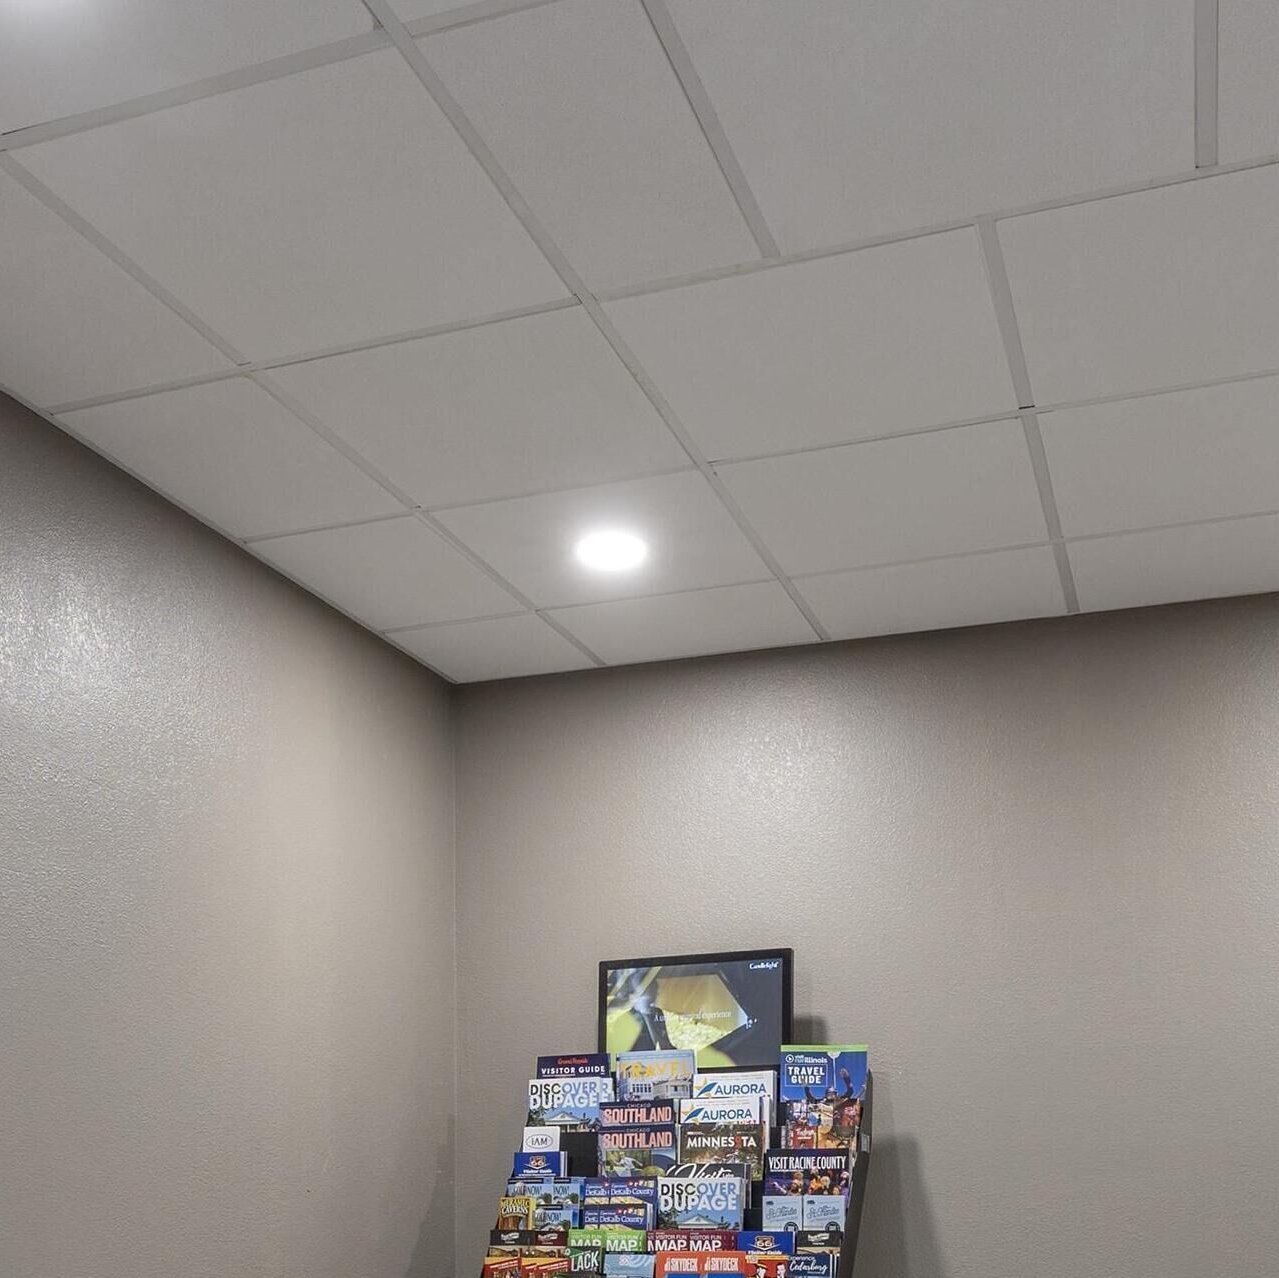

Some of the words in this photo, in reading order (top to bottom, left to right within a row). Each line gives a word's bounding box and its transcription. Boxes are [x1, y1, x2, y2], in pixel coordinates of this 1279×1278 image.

[750, 962, 779, 970] Candlelight
[620, 1060, 688, 1079] TRAVEL
[788, 1067, 825, 1075] TRAVEL
[530, 1082, 597, 1095] DISCOVER
[715, 1084, 766, 1095] AURORA
[529, 1095, 597, 1110] DUPAGE
[603, 1107, 671, 1124] SOUTHLAND
[702, 1109, 752, 1120] AURORA
[603, 1132, 672, 1149] SOUTHLAND
[769, 1156, 787, 1170] VISIT
[789, 1156, 816, 1168] RACINE
[818, 1156, 847, 1169] COUNTY
[632, 1188, 653, 1196] County
[661, 1183, 736, 1196] DISCOVER
[502, 1205, 528, 1214] CAVERNS
[660, 1196, 737, 1211] DUPAGE
[621, 1216, 643, 1224] County
[607, 1240, 637, 1251] MAP
[655, 1240, 685, 1251] MAP
[690, 1240, 721, 1251] MAP
[572, 1251, 598, 1270] LACK
[670, 1258, 697, 1271] SKYDECK
[711, 1258, 738, 1271] SKYDECK
[789, 1260, 827, 1274] Cedarburg
